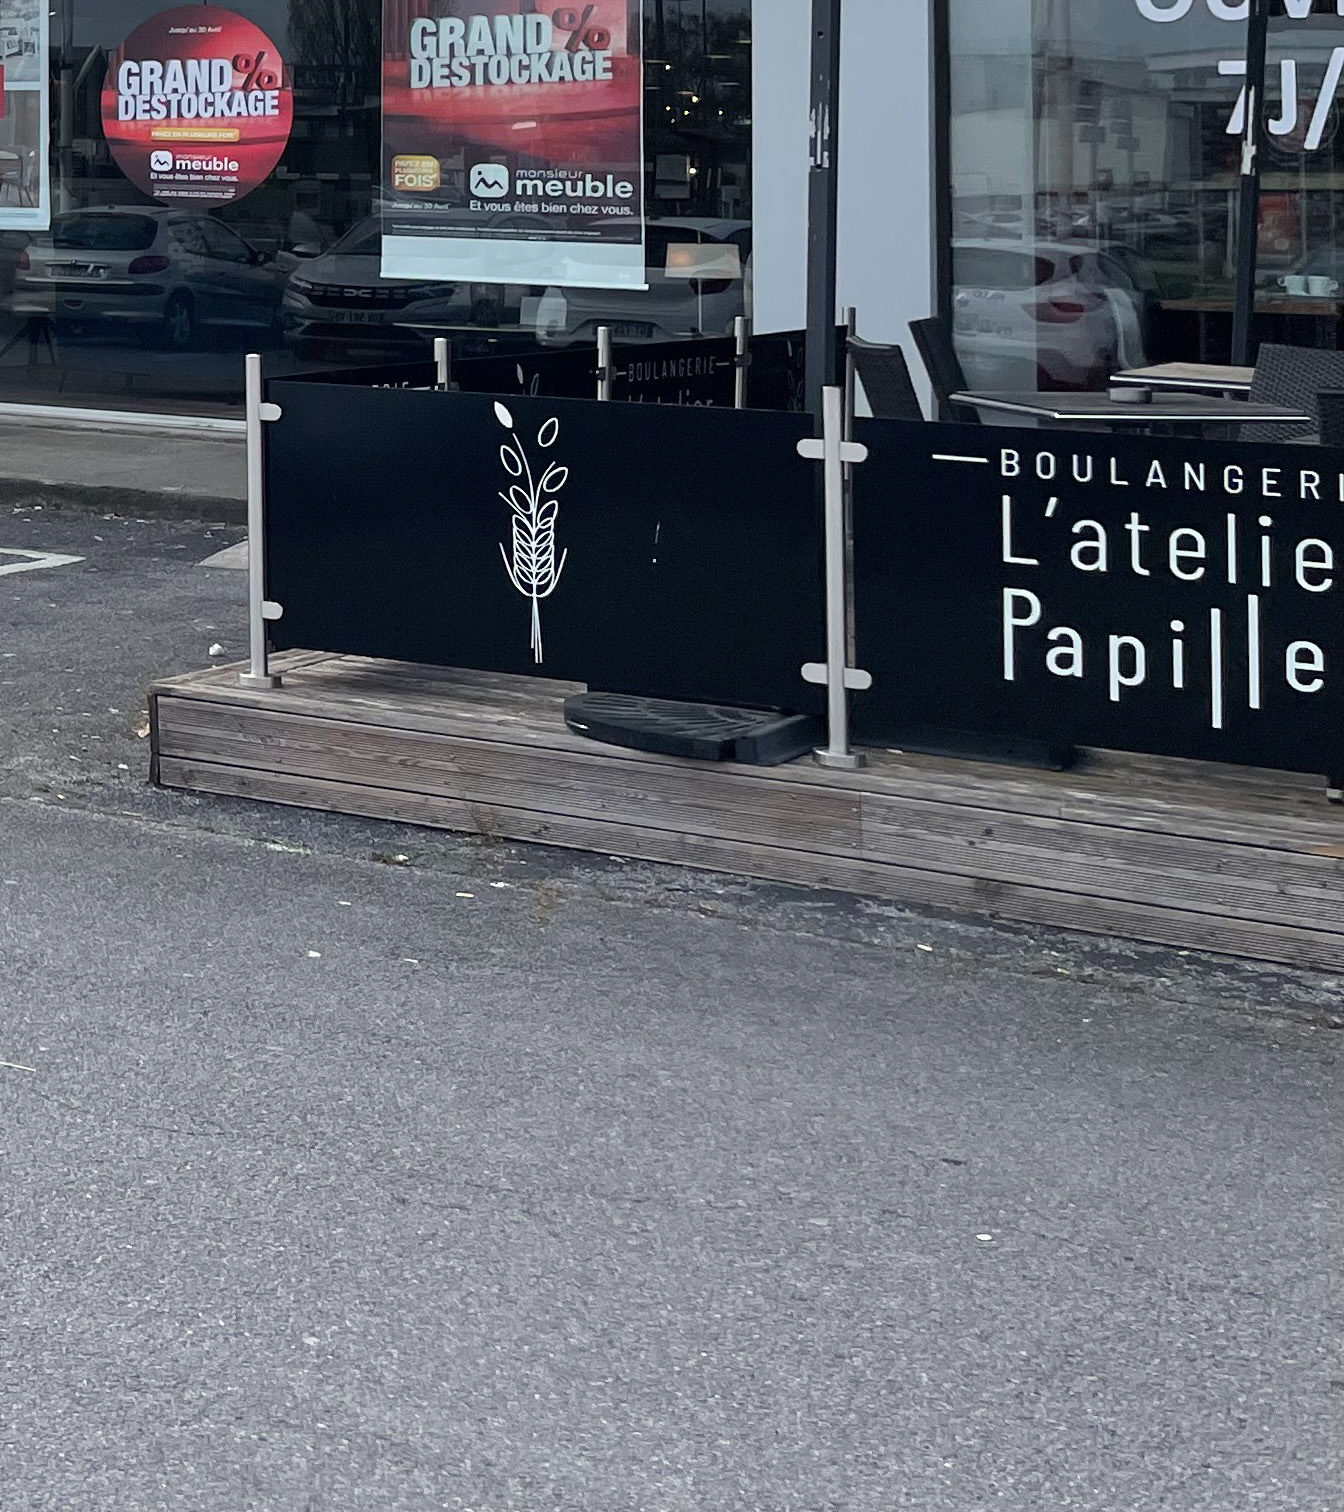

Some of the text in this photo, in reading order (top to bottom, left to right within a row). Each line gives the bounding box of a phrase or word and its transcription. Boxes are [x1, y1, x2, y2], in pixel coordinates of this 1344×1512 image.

[410, 13, 553, 60] GRAND
[118, 59, 233, 95] GRAND
[409, 49, 613, 89] DESTOCKAGE
[118, 90, 280, 121] DESTOCKAGE
[175, 156, 240, 172] meuble
[516, 168, 583, 178] monsieur
[515, 174, 633, 198] meuble
[470, 200, 634, 215] Et vous êtes bien chez vous.
[628, 356, 716, 383] BOULANGERIE
[1002, 494, 1333, 593] L'atelie
[1003, 586, 1325, 729] Papille
